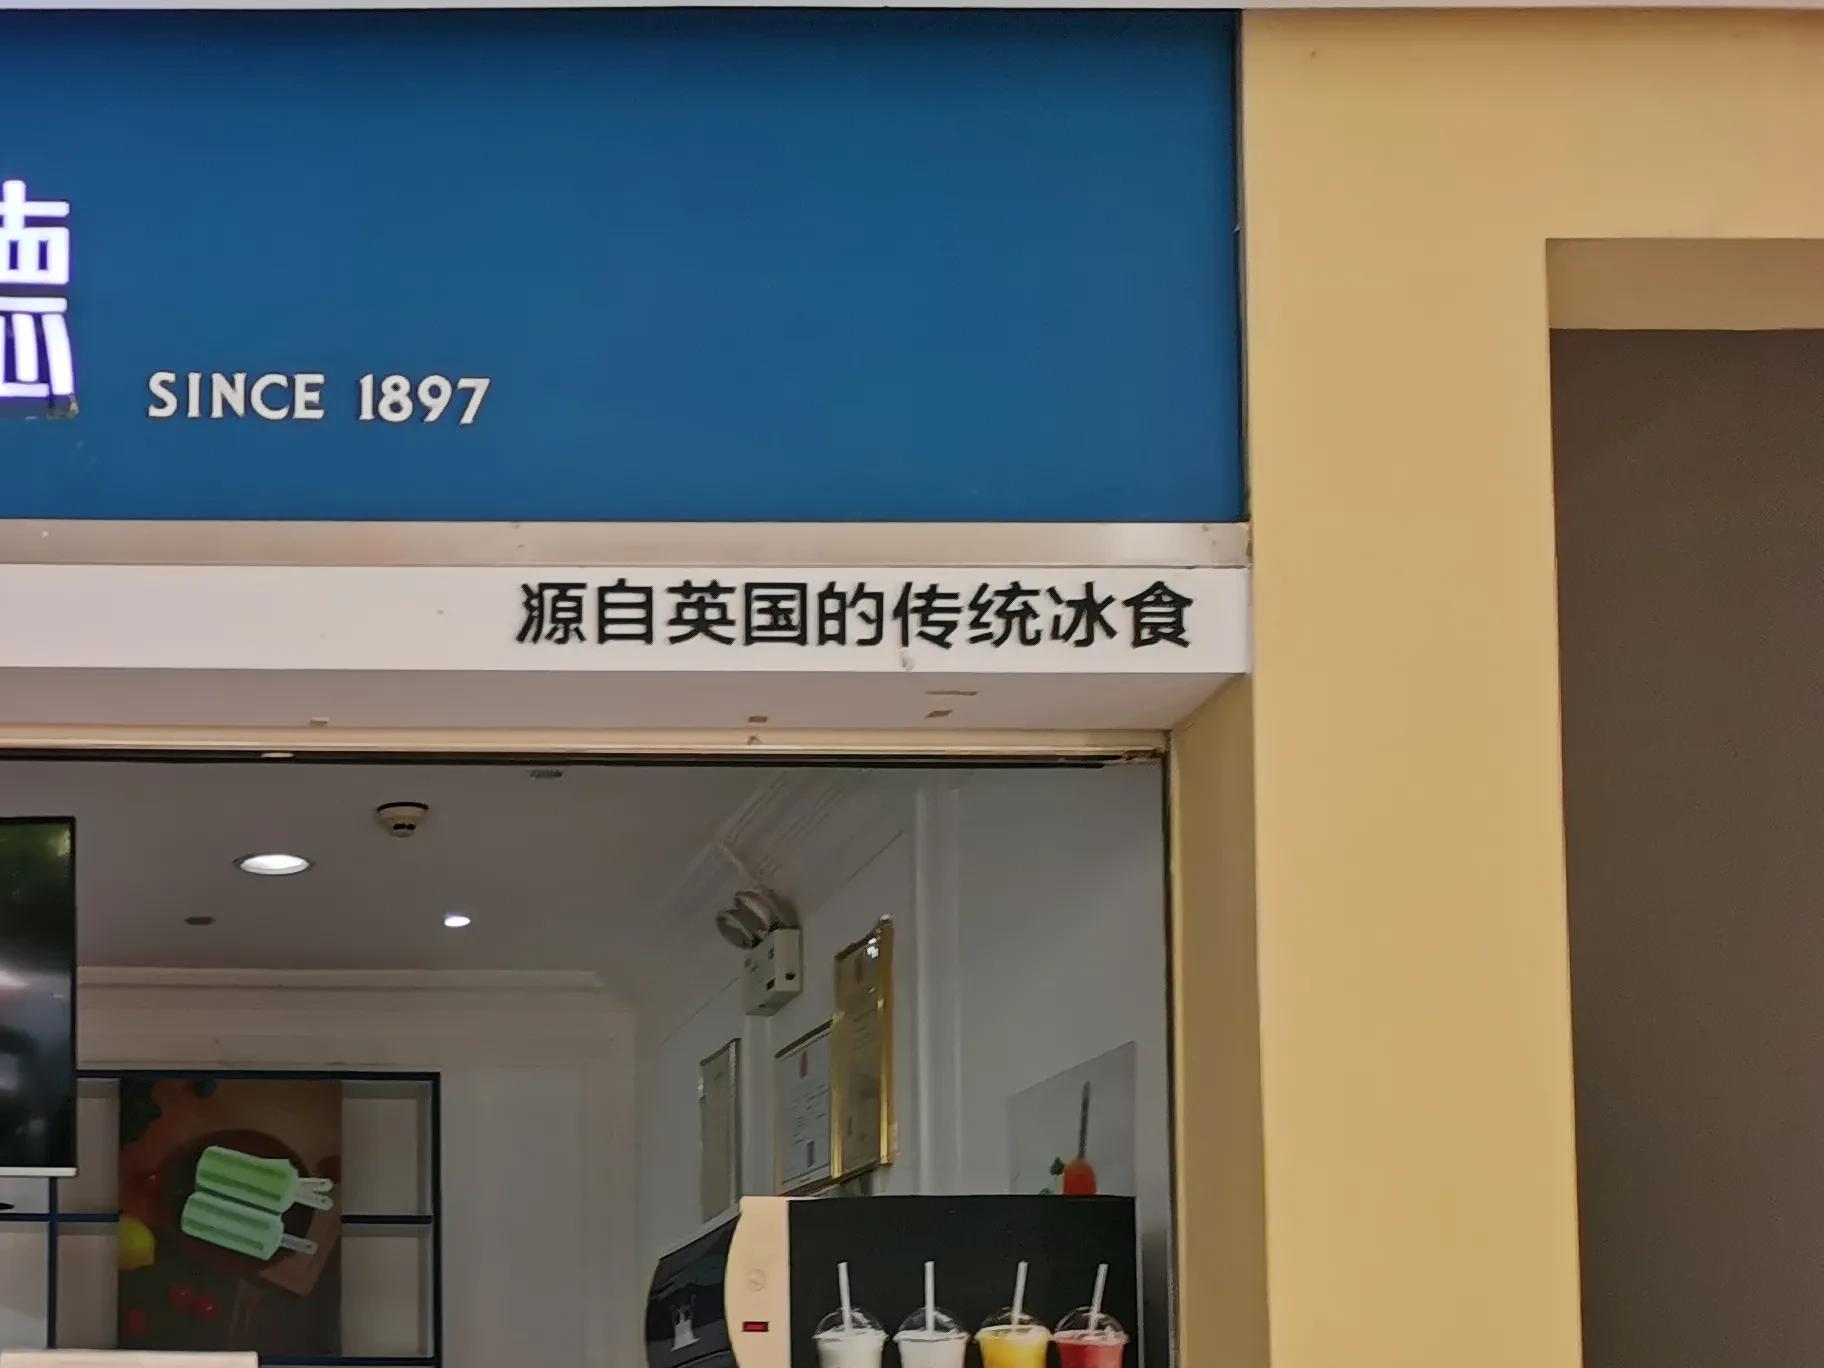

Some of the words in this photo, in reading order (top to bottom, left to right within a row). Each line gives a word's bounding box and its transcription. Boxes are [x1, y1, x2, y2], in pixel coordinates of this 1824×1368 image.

[147, 370, 326, 423] SINCE
[357, 372, 493, 427] 1897
[516, 578, 1195, 650] 源自英国的传统冰食
